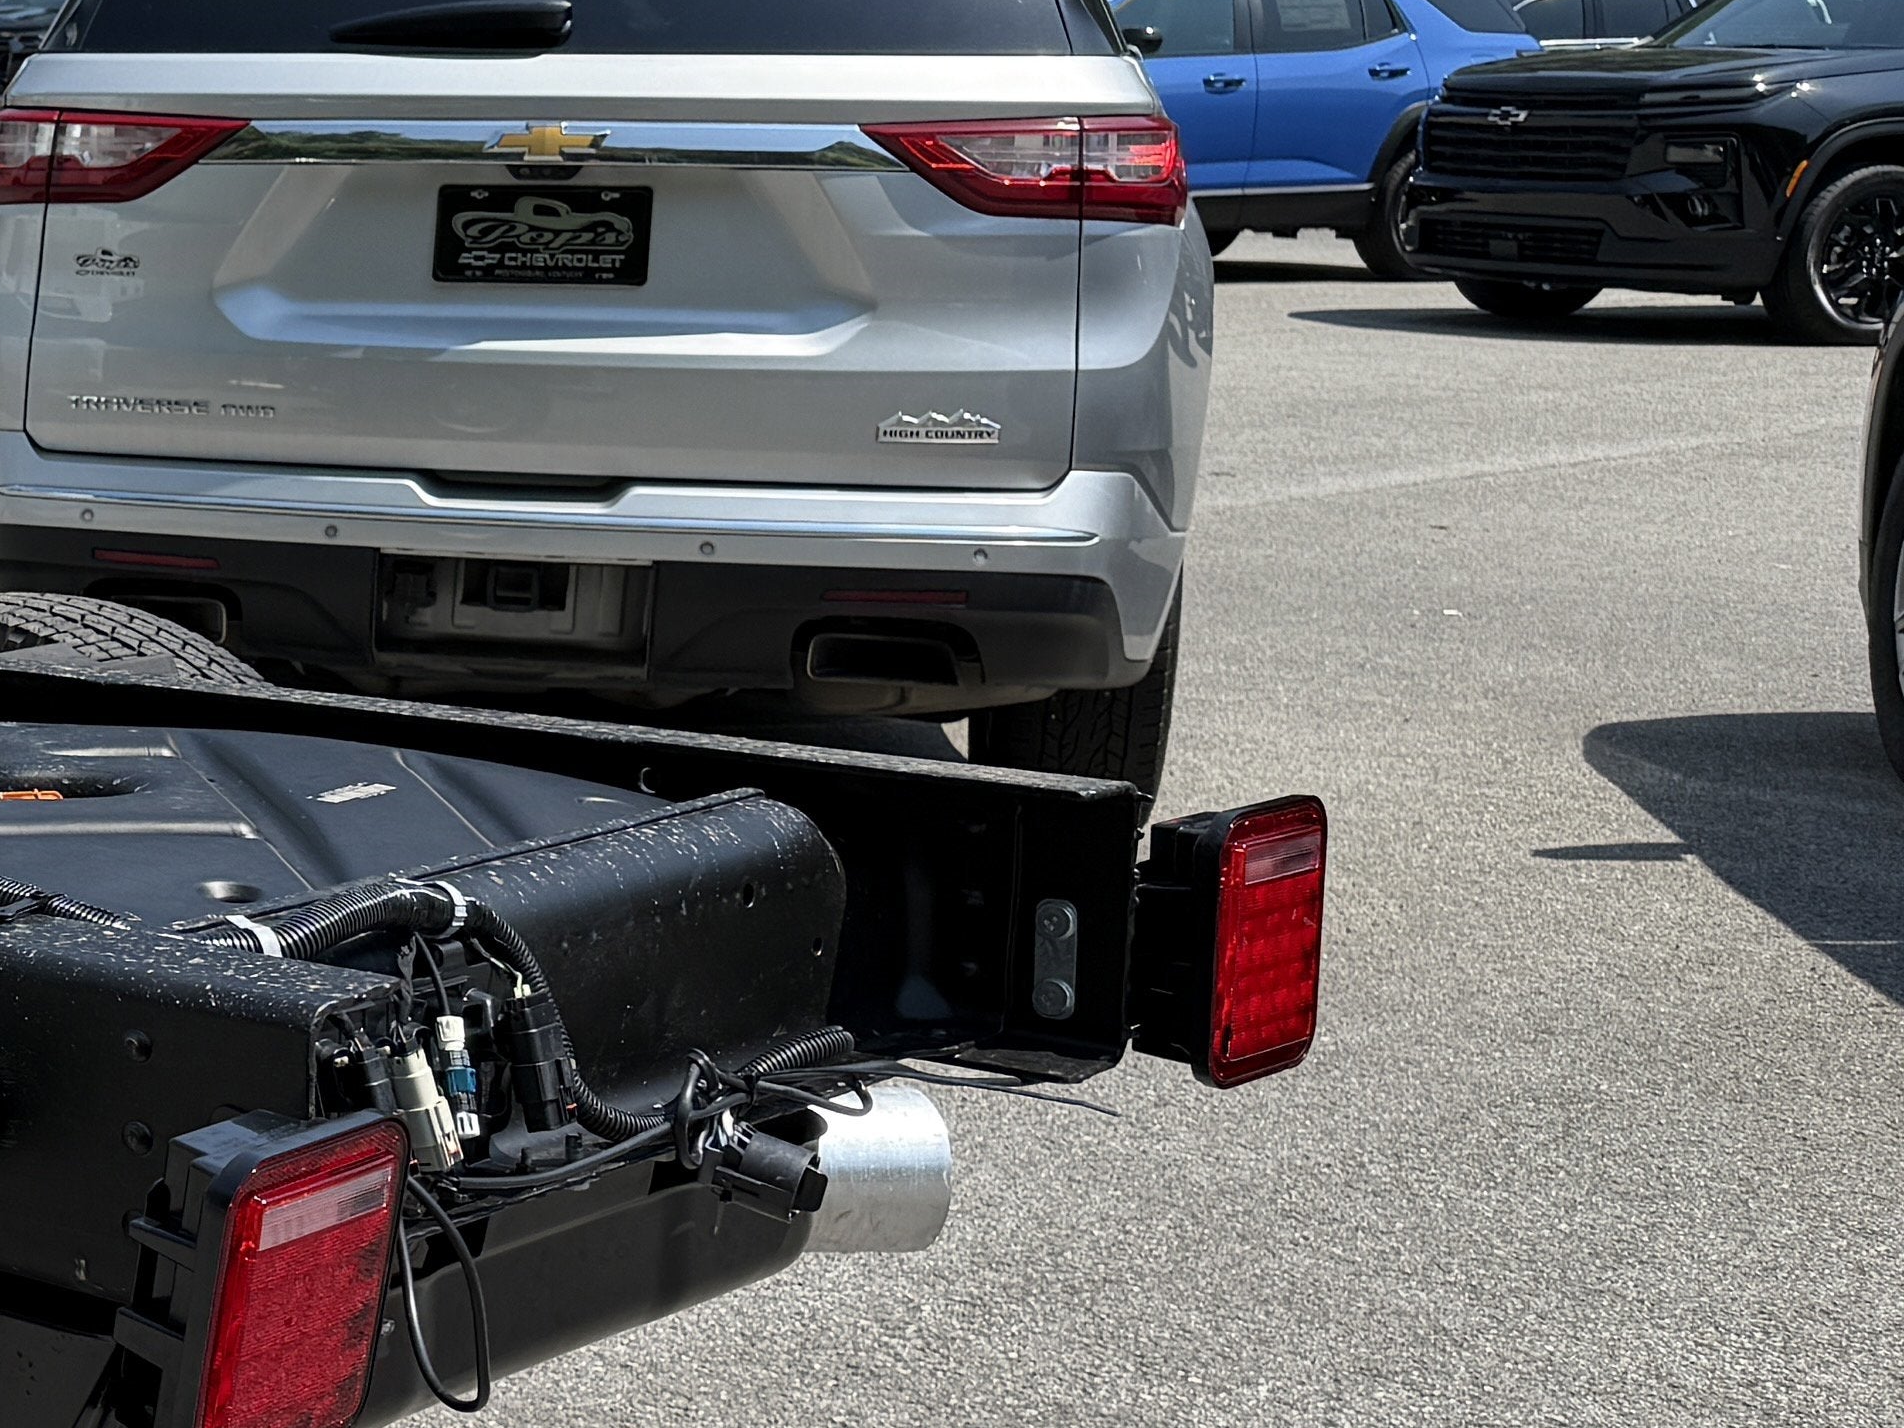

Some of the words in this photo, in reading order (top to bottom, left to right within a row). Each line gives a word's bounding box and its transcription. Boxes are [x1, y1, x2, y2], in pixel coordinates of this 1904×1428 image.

[503, 253, 625, 268] CHEVROLET
[67, 395, 210, 416] TRAVERSE
[882, 429, 920, 439] HIGH
[924, 429, 996, 440] COUNTRY
